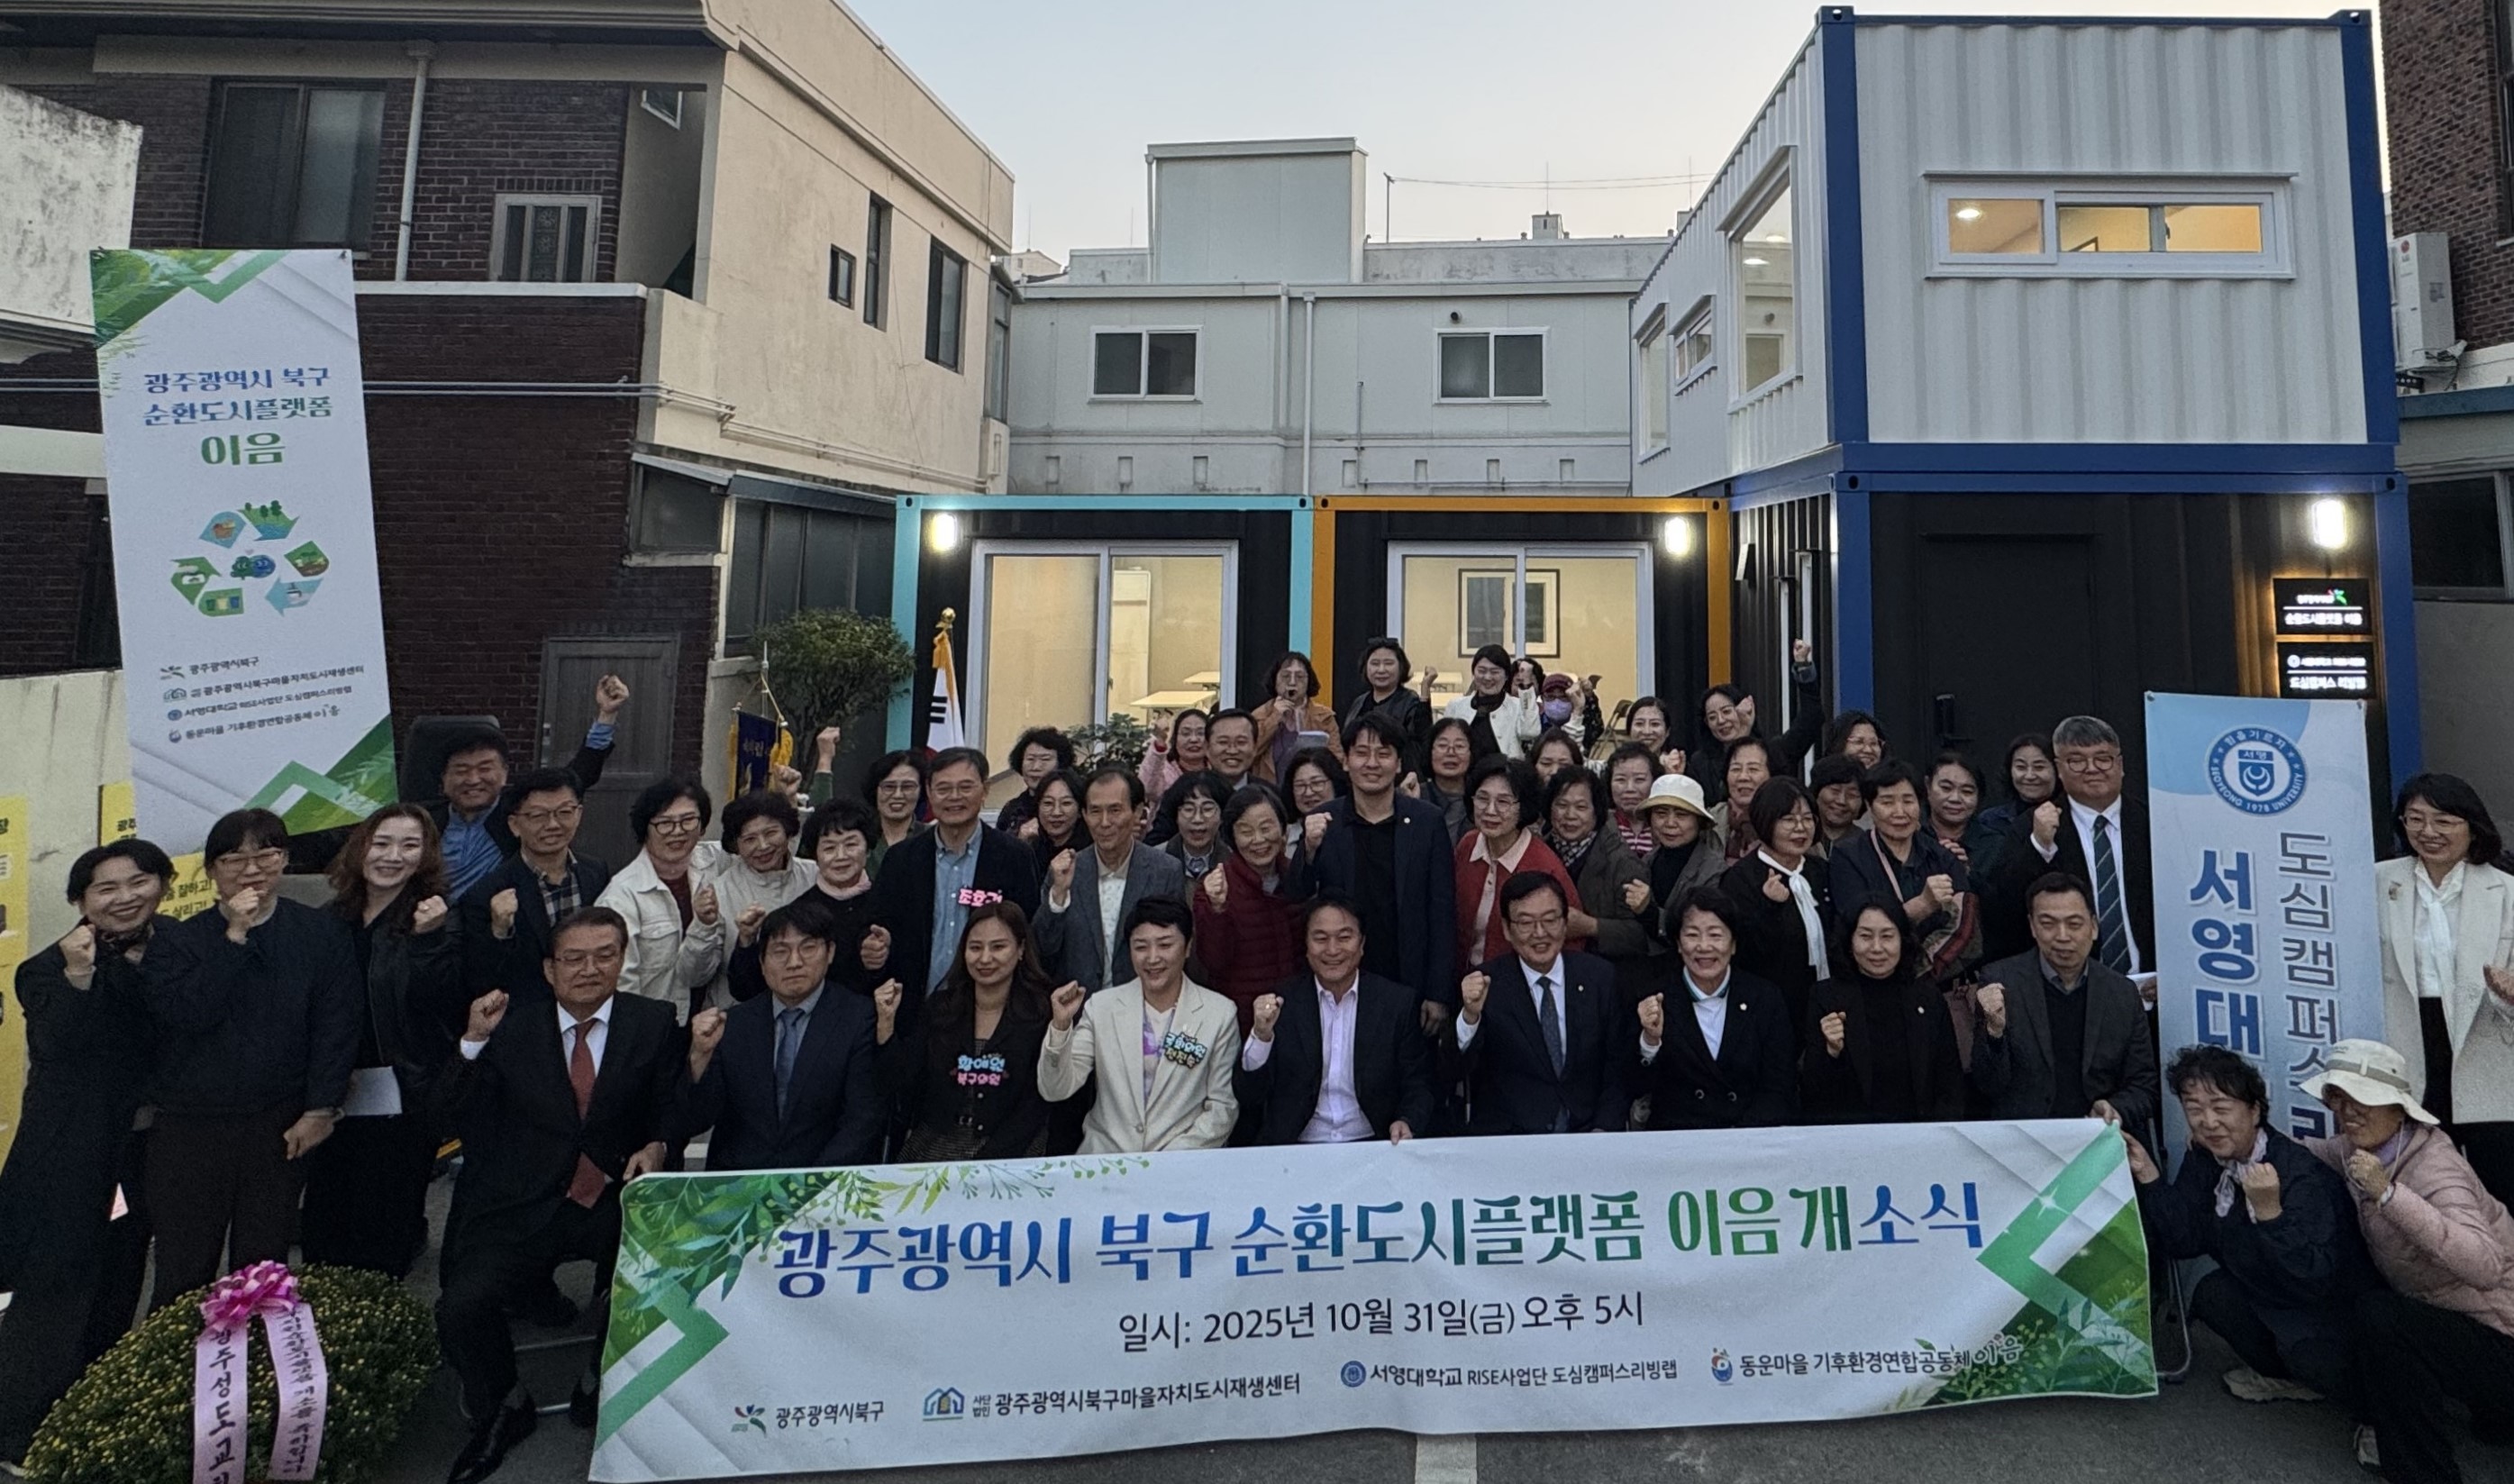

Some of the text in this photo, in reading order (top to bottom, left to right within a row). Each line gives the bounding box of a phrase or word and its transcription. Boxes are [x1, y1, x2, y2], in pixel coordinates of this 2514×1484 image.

[143, 367, 331, 394] 광주광역시 북구
[143, 396, 332, 426] 순환도시플랫폼
[201, 432, 286, 465] 이음
[188, 656, 260, 675] 광주광역시북구
[773, 1217, 1072, 1298] 광주광역시
[1095, 1211, 1215, 1281] 북구
[1230, 1189, 1645, 1277] 순환도시플랫폼
[1118, 1311, 1191, 1352] 일시:
[1203, 1301, 1315, 1343] 2025년
[1326, 1297, 1394, 1336] 10월
[1594, 1290, 1644, 1326] 5시
[1370, 1359, 1678, 1388] 서영대학교 RISE사업단 도심캠퍼스리빙랩
[1739, 1353, 1808, 1377] 동운마을
[1813, 1350, 1971, 1374] 기후환경연합공동체
[994, 1372, 1300, 1416] 광주광역시북구마을자치도시재생센터
[776, 1401, 885, 1430] 광주광역시북구
